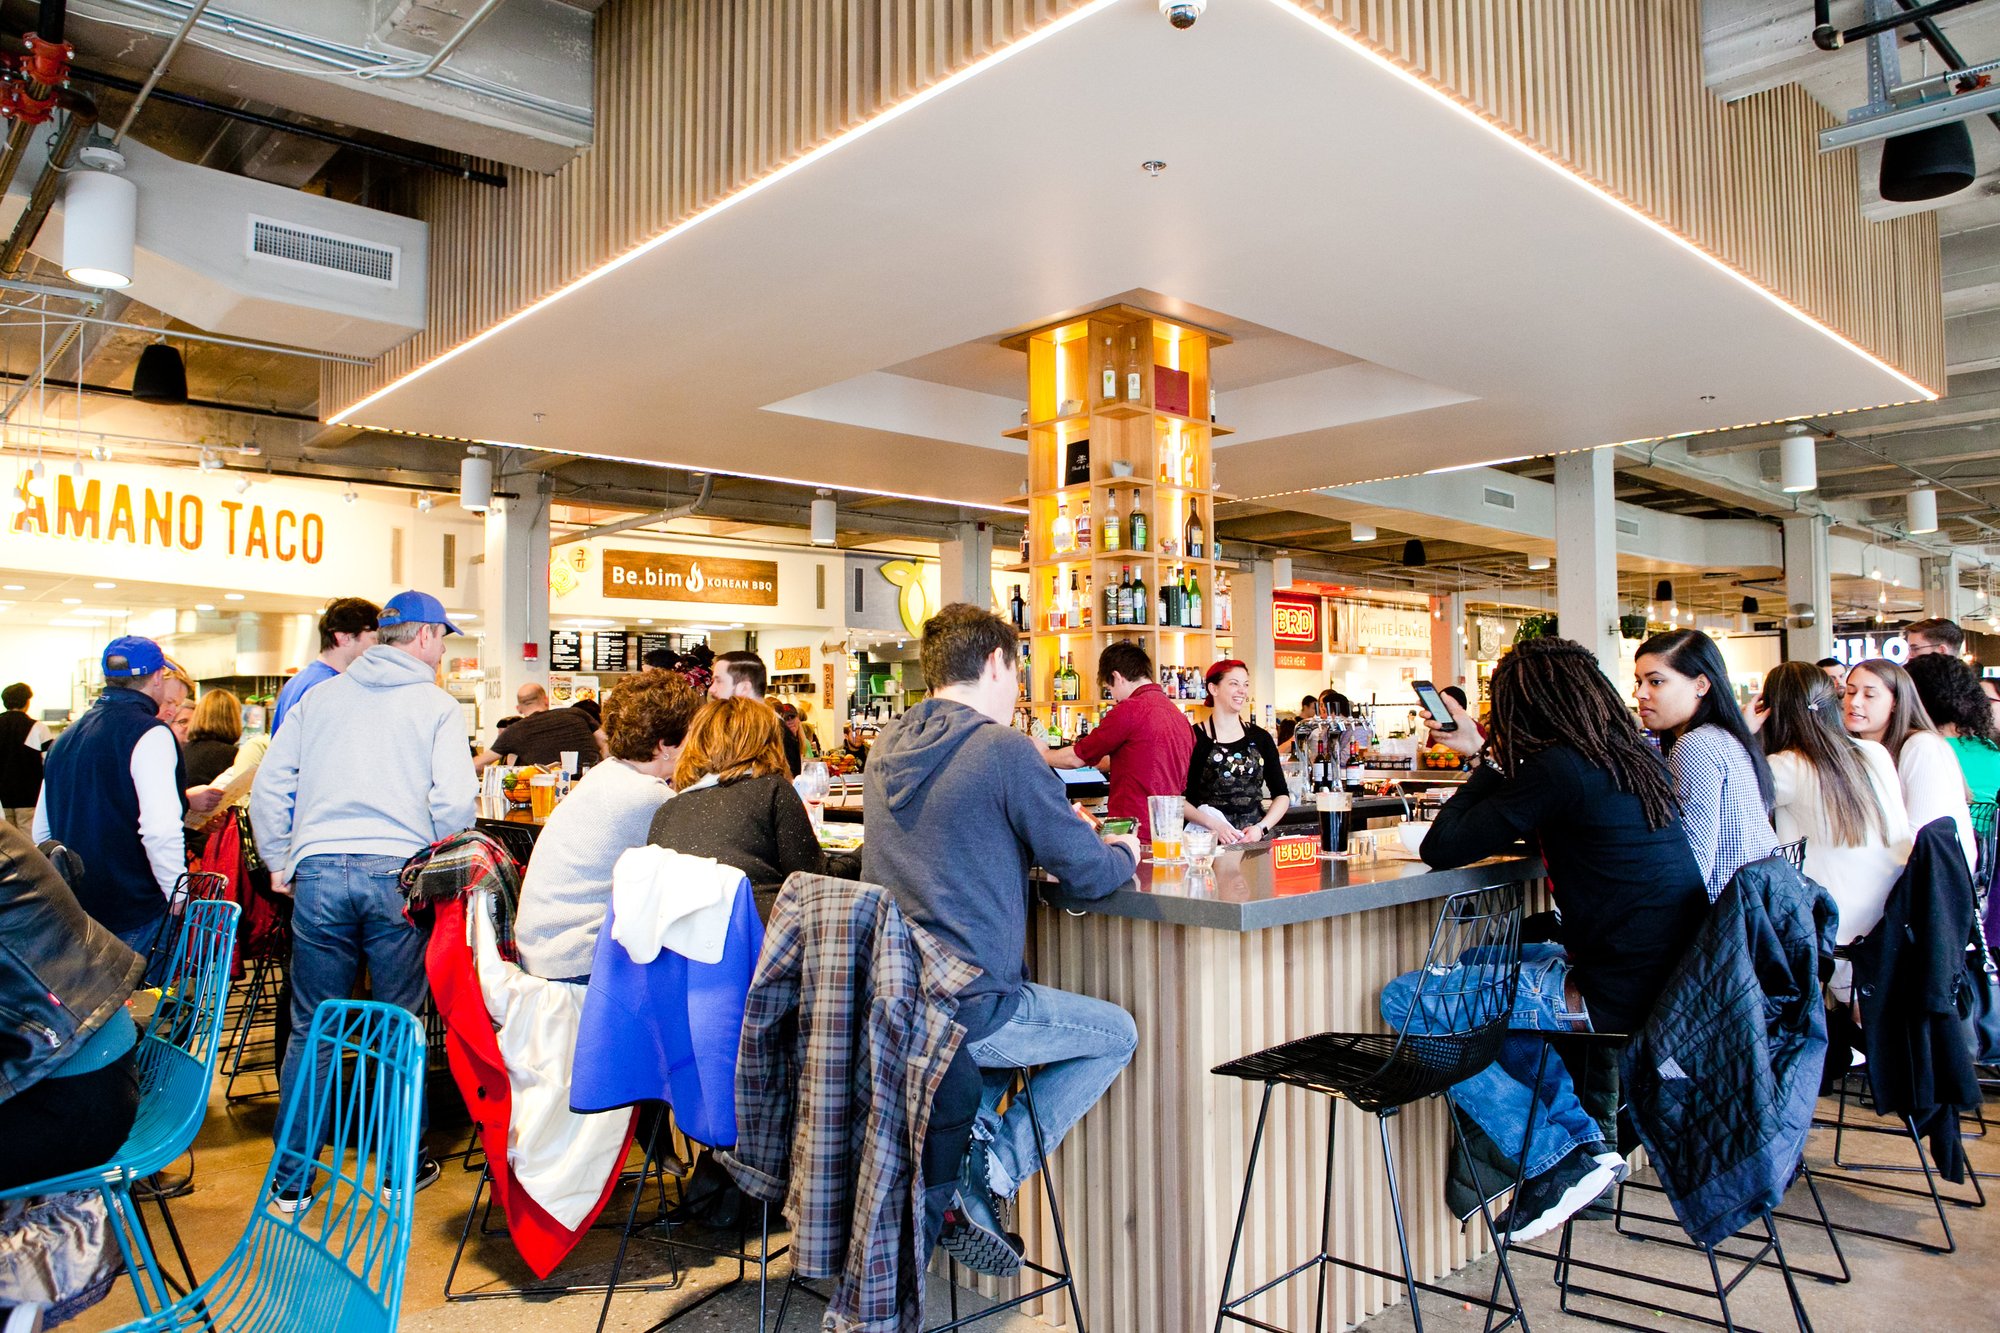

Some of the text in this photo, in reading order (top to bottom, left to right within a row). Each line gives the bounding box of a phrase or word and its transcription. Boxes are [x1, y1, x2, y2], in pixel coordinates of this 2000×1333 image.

[11, 469, 323, 564] AMANO TACO
[612, 566, 772, 592] Be.bim KOREAN BBQ
[1276, 608, 1312, 635] BRD
[1360, 622, 1393, 636] WHITE
[485, 681, 501, 699] TACO
